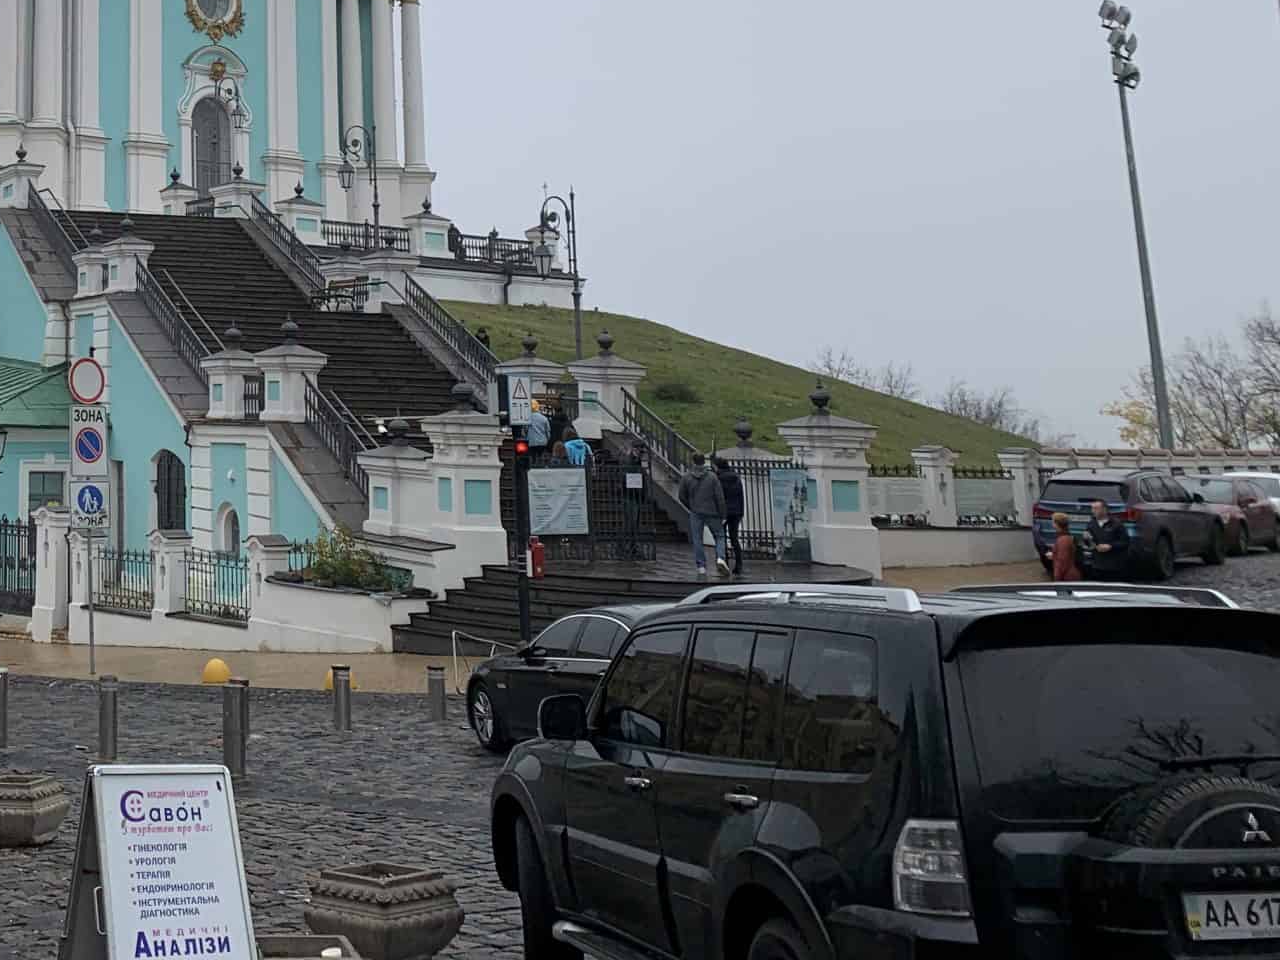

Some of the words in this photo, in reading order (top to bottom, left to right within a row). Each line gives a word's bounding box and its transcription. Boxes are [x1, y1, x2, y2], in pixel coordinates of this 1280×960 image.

[73, 409, 104, 423] ЗОНА
[133, 843, 187, 852] ГІНЕКОЛОГІЯ
[135, 857, 176, 866] УРОЛОГІЯ
[136, 871, 171, 879] ТЕРАПІЯ
[137, 882, 215, 894] ЕНДОКРИНОЛОГІЯ
[138, 896, 220, 907] ІНСТРУМЕНТАЛЬНА
[140, 908, 200, 920] ДІАГНОСТИКА
[1206, 899, 1239, 927] AA
[152, 925, 228, 937] МЕДИЧНІ
